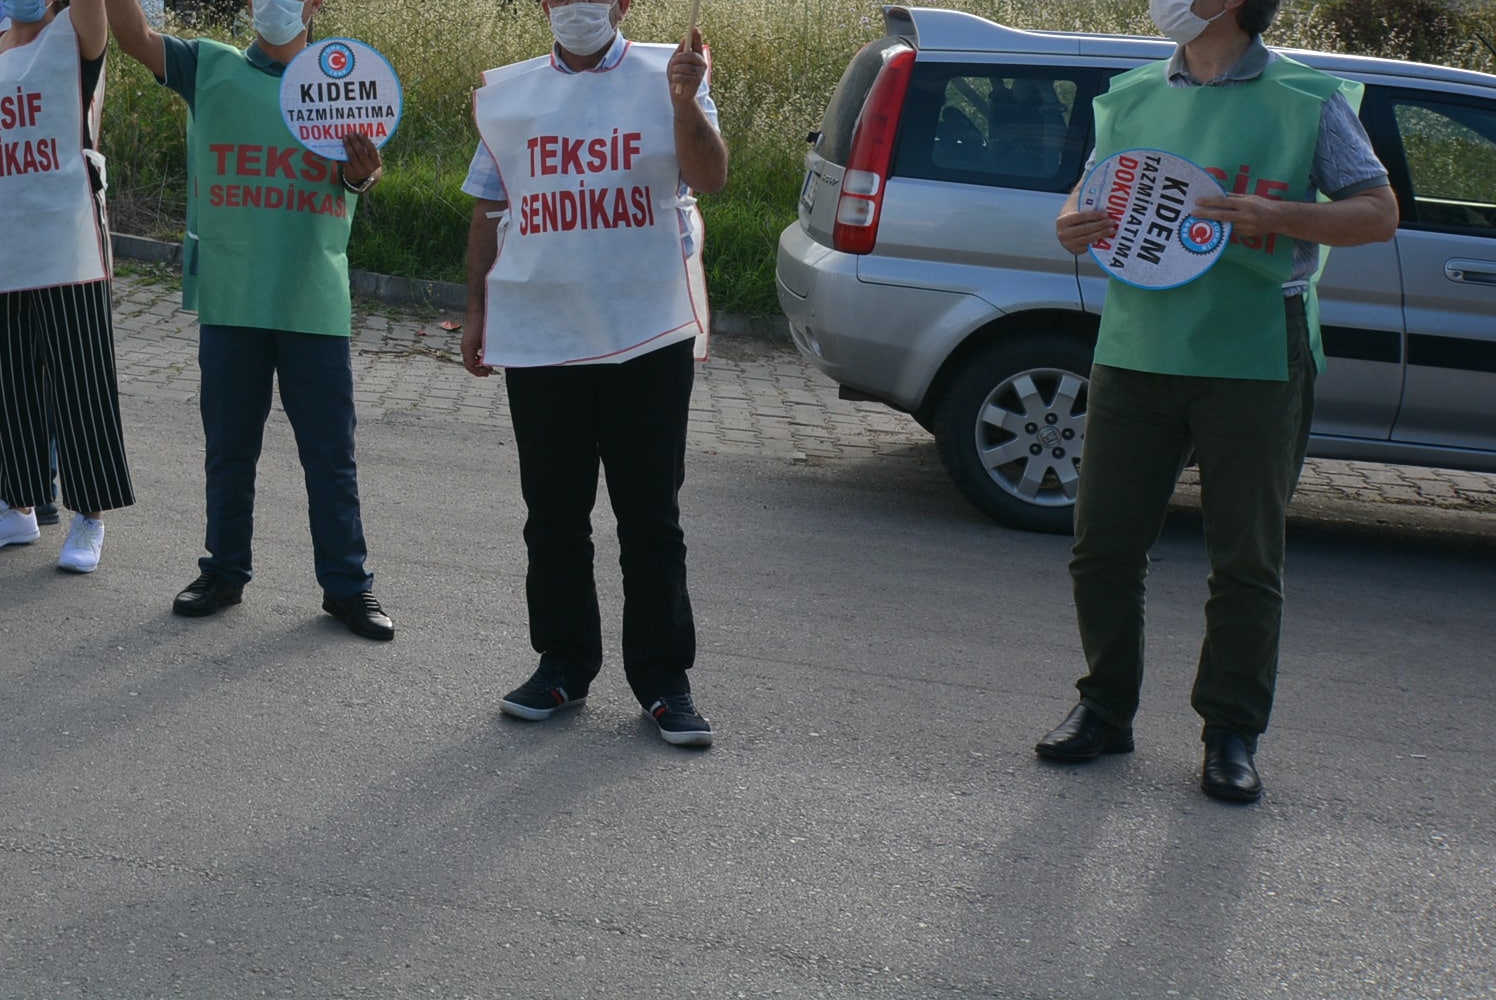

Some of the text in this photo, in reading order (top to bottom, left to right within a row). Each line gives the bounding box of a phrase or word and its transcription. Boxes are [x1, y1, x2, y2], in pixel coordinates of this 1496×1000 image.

[287, 104, 395, 122] TAZMİNATIMA
[300, 80, 378, 103] KIDEM
[299, 122, 388, 141] DOKUNMA
[527, 128, 642, 178] TEKSİF
[209, 183, 347, 219] SENDİKASI
[520, 179, 654, 236] SENDİKASI
[1109, 154, 1162, 270] TAZMİNATIMA
[1137, 176, 1190, 266] KIDEM
